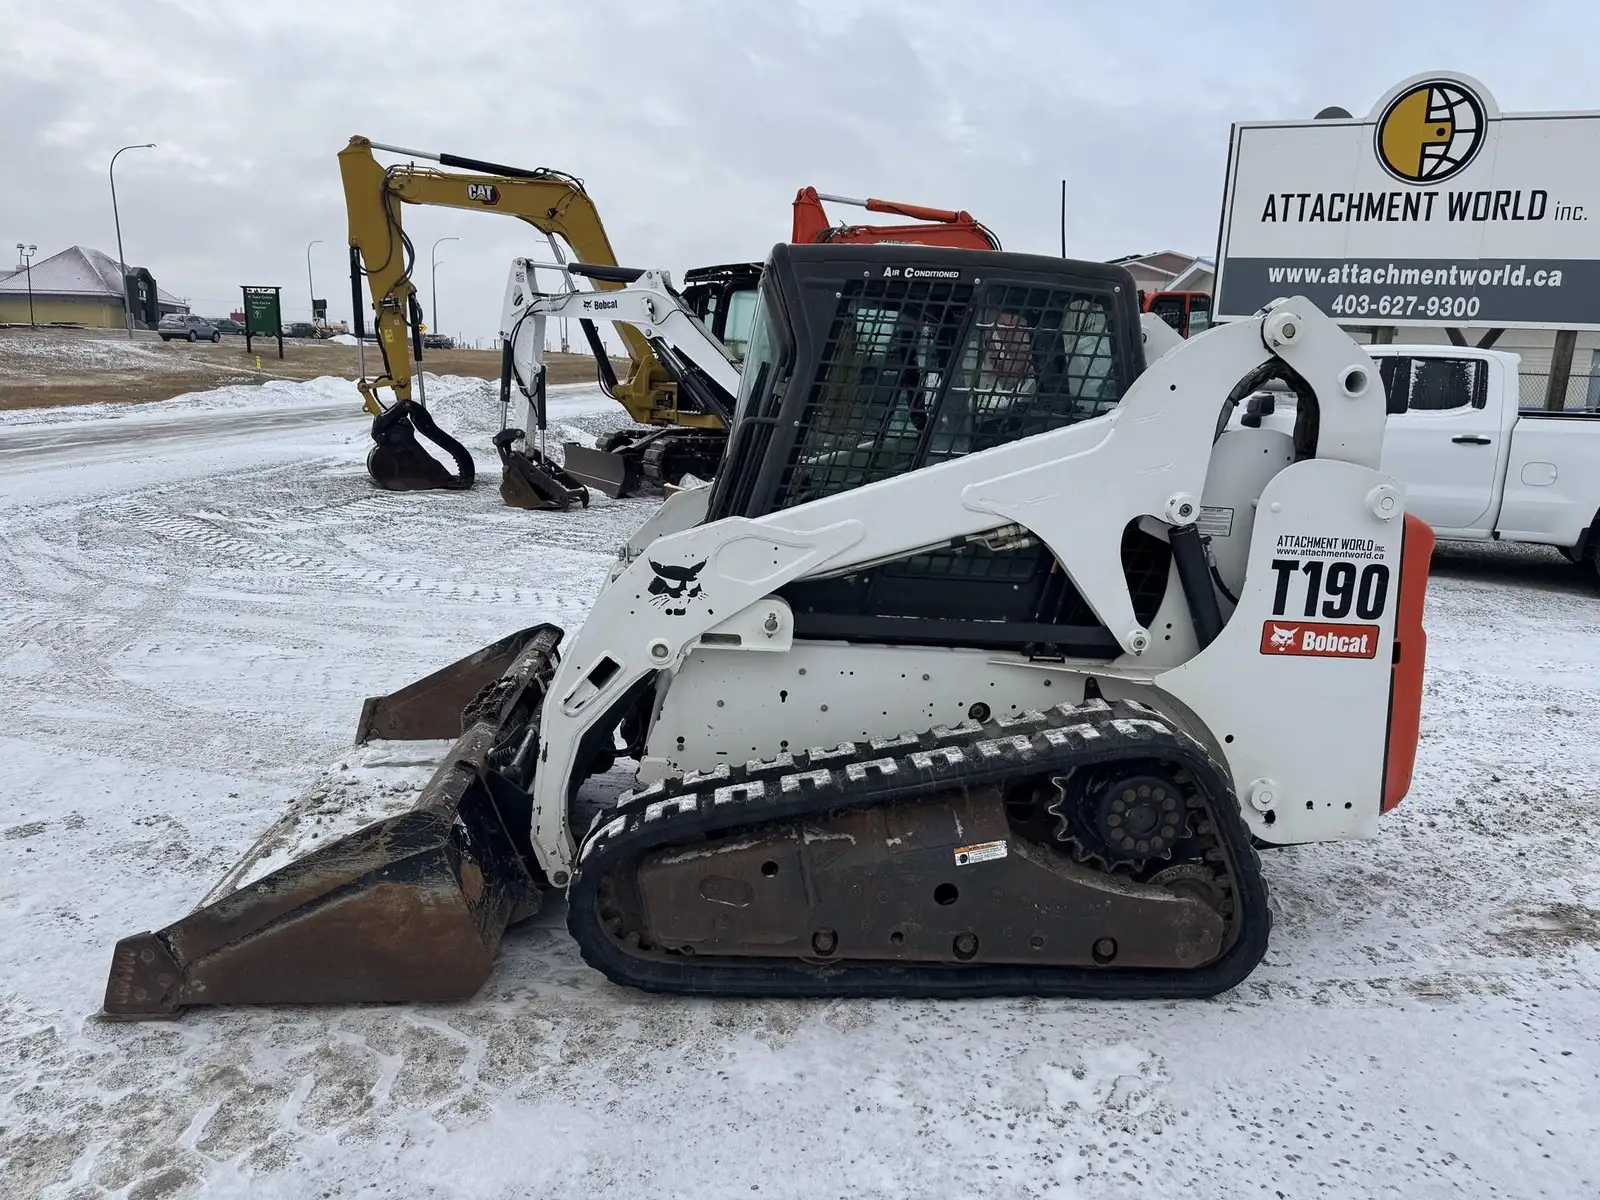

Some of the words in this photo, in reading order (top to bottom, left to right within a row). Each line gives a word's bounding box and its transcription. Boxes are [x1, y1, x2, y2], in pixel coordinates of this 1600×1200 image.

[468, 184, 493, 200] CAT
[1261, 191, 1439, 222] ATTACHMENT
[1448, 190, 1548, 222] WORLD
[1554, 201, 1588, 221] inc.
[1268, 264, 1563, 287] www.attachmentworld.ca
[594, 300, 618, 310] Bobcat
[1331, 295, 1480, 317] 403-627-9300
[1276, 548, 1384, 560] www.attachmentworld.ca
[1277, 535, 1339, 549] ATTACHMENT
[1341, 538, 1374, 551] WORLD
[1374, 544, 1385, 552] inc.
[1271, 559, 1390, 621] T190
[1301, 630, 1368, 653] Bobcat
